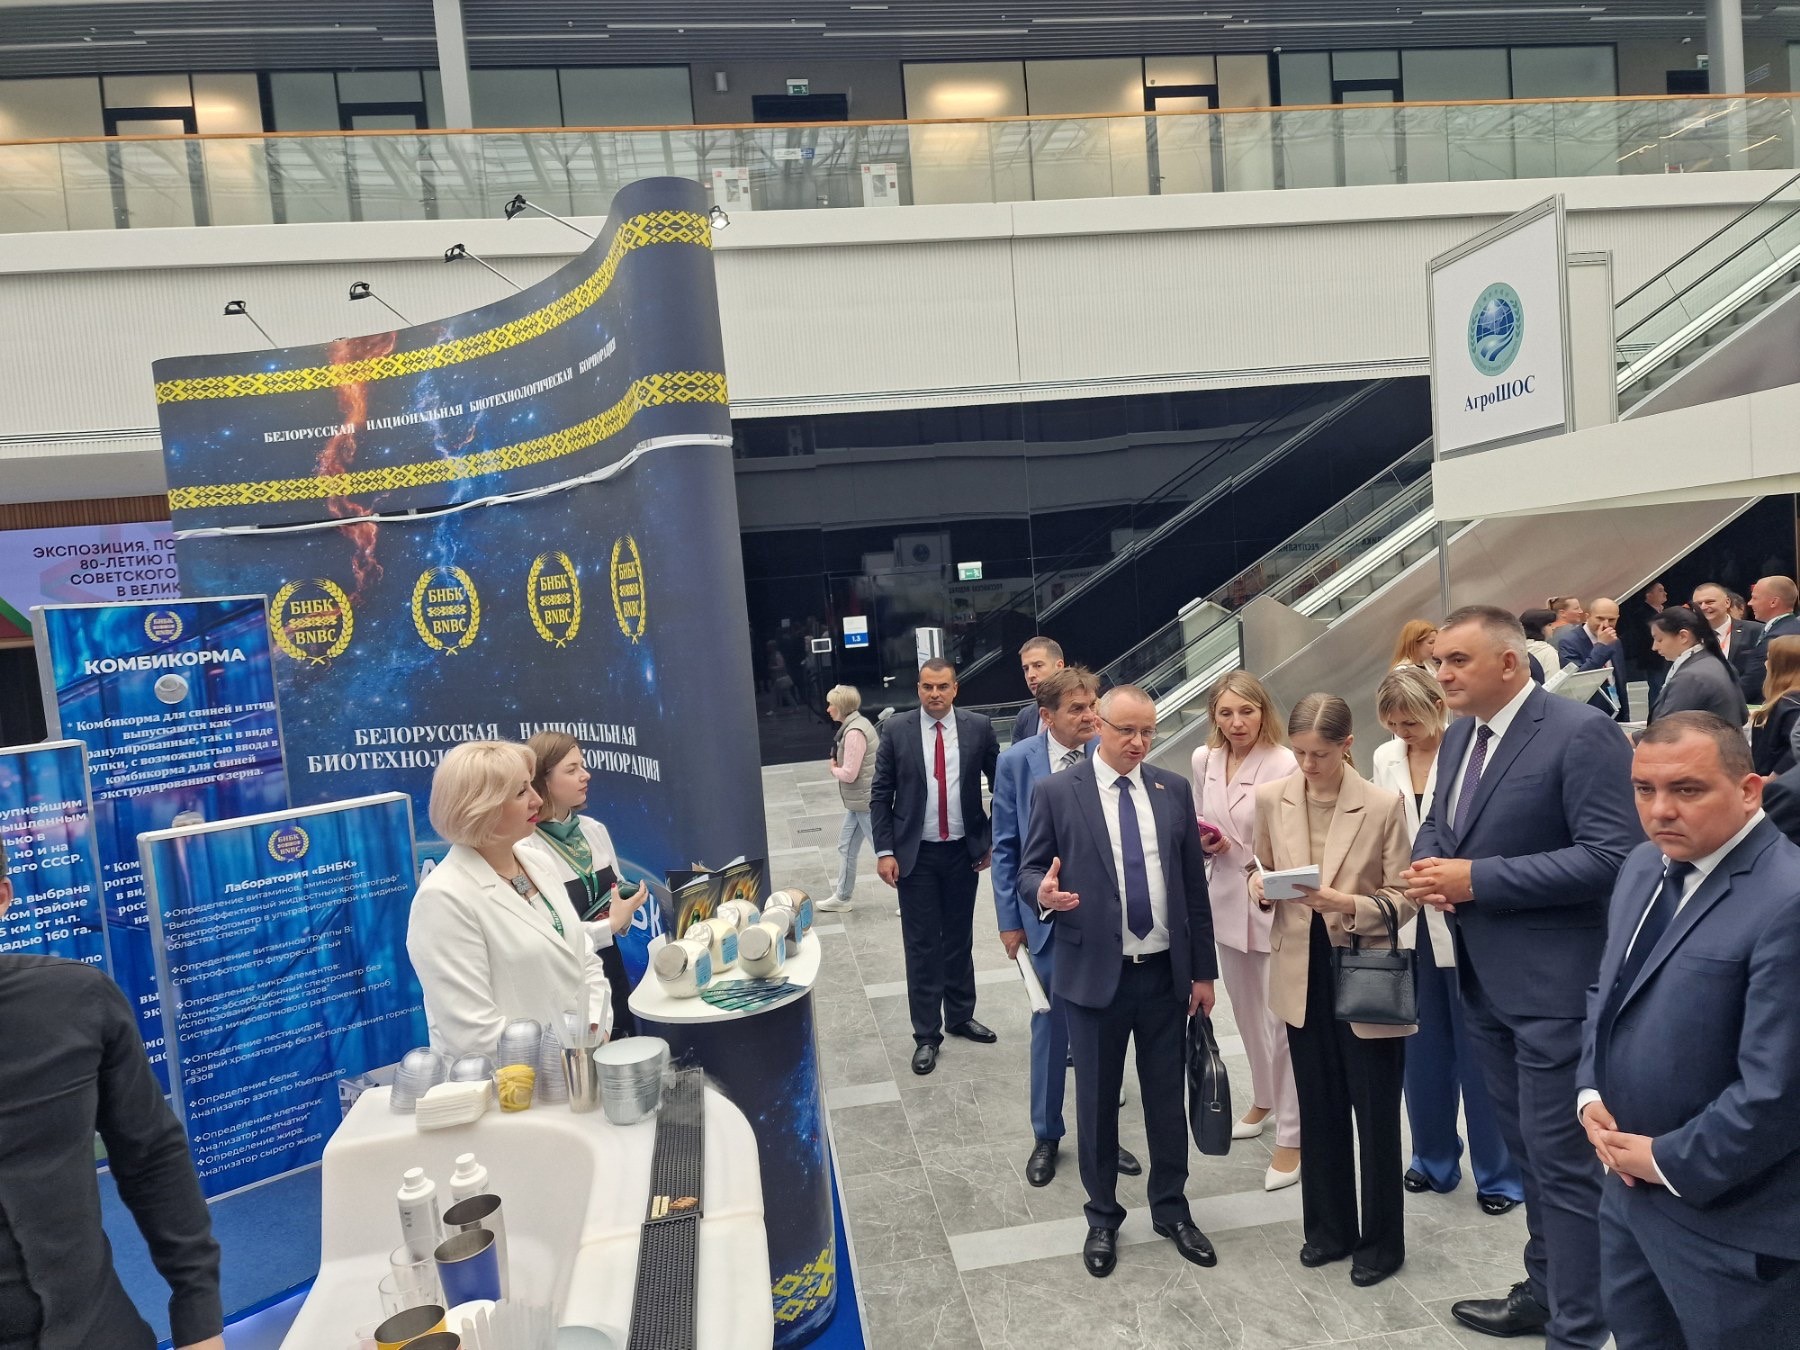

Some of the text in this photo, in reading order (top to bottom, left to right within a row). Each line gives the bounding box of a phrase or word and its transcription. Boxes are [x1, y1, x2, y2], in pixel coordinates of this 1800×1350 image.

[264, 337, 617, 443] БЕЛОРУССКАЯ НАЦИОНАЛЬНАЯ БИОТЕХНОЛОГИЧЕСКАЯ КОРПОРАЦИЯ
[1464, 375, 1536, 412] АгроШОС
[154, 539, 176, 550] ПО
[80, 553, 177, 570] 80-ЛЕТИЮ П
[619, 562, 638, 578] БНБК
[70, 568, 176, 586] СОВЕТСКОГО
[540, 575, 570, 592] БНБК
[117, 583, 181, 597] В ВЕЛИК
[428, 587, 464, 604] БНБК
[290, 599, 334, 616] БНБК
[544, 608, 572, 626] BNBC
[622, 601, 640, 618] BNBC
[295, 629, 337, 645] BNBC
[432, 618, 468, 634] BNBC
[84, 648, 246, 675] КОМБИКОРМА
[77, 713, 160, 731] Комбикорма
[163, 711, 186, 722] для
[189, 705, 232, 717] свиней
[123, 720, 231, 740] выпускаются как
[354, 723, 498, 746] БЕЛОРУССКАЯ
[87, 738, 198, 761] ранулированные,
[201, 734, 222, 744] так
[225, 732, 232, 740] и
[246, 727, 273, 738] виде
[88, 761, 128, 774] упки,
[140, 746, 232, 764] возможностью
[235, 741, 269, 752] ввода
[307, 748, 449, 773] БИОТЕХНОЛ
[105, 754, 256, 785] комбикорма для свиней
[100, 767, 264, 800] экструдированного зерна.
[0, 800, 82, 820] упнейшим
[0, 813, 87, 832] ышленным
[2, 833, 46, 846] ько в
[277, 833, 300, 844] БНБК
[15, 843, 69, 859] но и на
[6, 853, 84, 876] его СССР.
[113, 860, 140, 872] Ком
[224, 860, 357, 894] Лаборатория «БНБК»
[26, 884, 91, 904] выбрана
[116, 888, 146, 900] в ви
[272, 894, 358, 922] ультрафиолетовой
[368, 884, 408, 898] видимой
[278, 888, 338, 907] жидкостный
[2, 909, 30, 923] ком
[34, 898, 88, 918] районе
[118, 901, 146, 916] росс
[172, 897, 244, 917] Определение
[11, 924, 31, 935] км
[35, 920, 51, 930] от
[55, 914, 81, 926] н.п.
[0, 926, 92, 952] адью 160 га.
[168, 936, 214, 952] областях
[180, 950, 250, 972] Определение
[253, 938, 306, 955] витаминов
[308, 929, 342, 942] группы
[172, 958, 263, 987] Спектрофотометр
[304, 968, 364, 989] спектрометр
[366, 964, 382, 973] без
[185, 985, 255, 1008] Определение
[178, 1004, 256, 1030] использования
[258, 994, 299, 1009] горючих
[180, 978, 391, 1042] Система микроволнового разложения проб
[184, 1059, 228, 1077] Газовый
[229, 1040, 294, 1064] хроматограф
[296, 1036, 312, 1046] без
[314, 1015, 384, 1040] использования
[192, 1038, 262, 1063] Определение
[186, 1072, 214, 1086] газов
[198, 1070, 300, 1106] Определение белка:
[190, 1068, 346, 1120] Анализатор азота по Кьельдалю
[203, 1114, 272, 1141] Определение
[198, 1132, 322, 1179] Анализатор сырого жира
[206, 1136, 274, 1164] Определение
